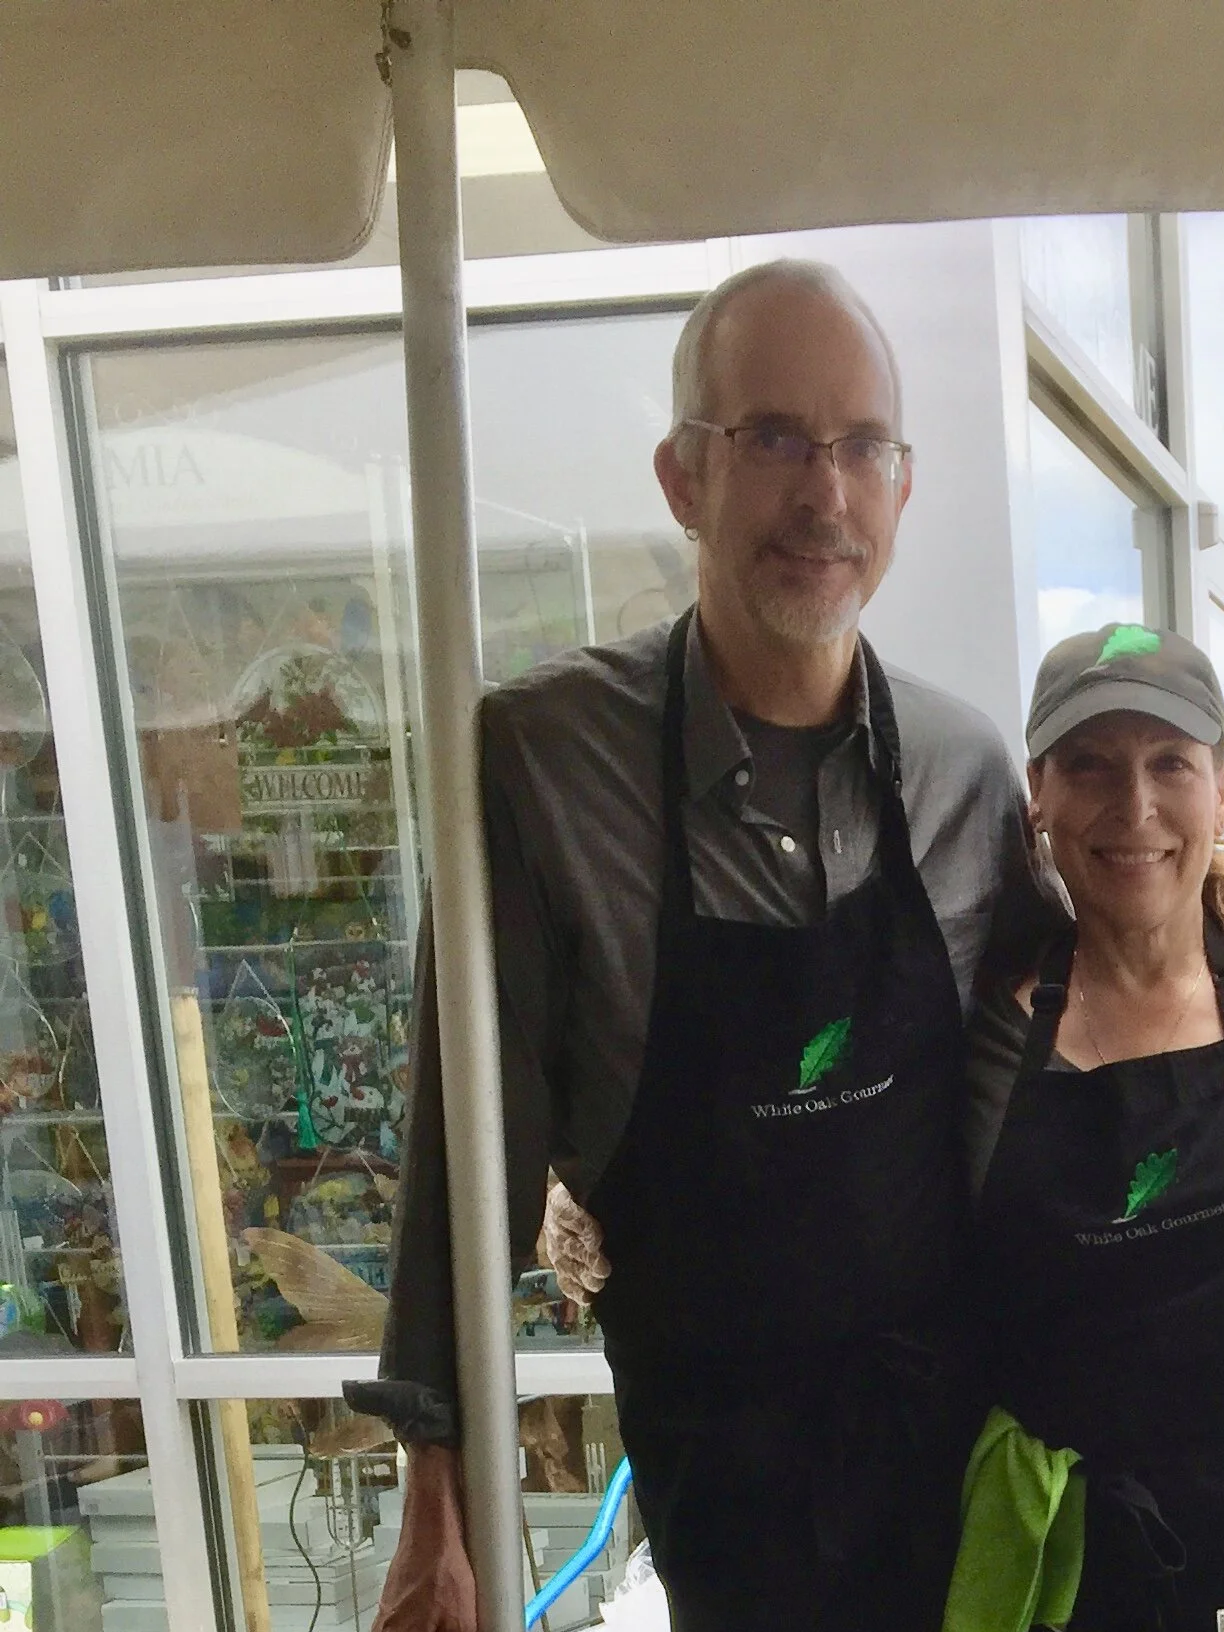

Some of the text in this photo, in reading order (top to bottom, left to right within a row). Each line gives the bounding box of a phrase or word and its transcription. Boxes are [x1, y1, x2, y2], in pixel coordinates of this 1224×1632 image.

[752, 1103, 801, 1118] White
[805, 1097, 838, 1112] Oak
[1075, 1233, 1123, 1245] White
[1126, 1223, 1159, 1239] Oak
